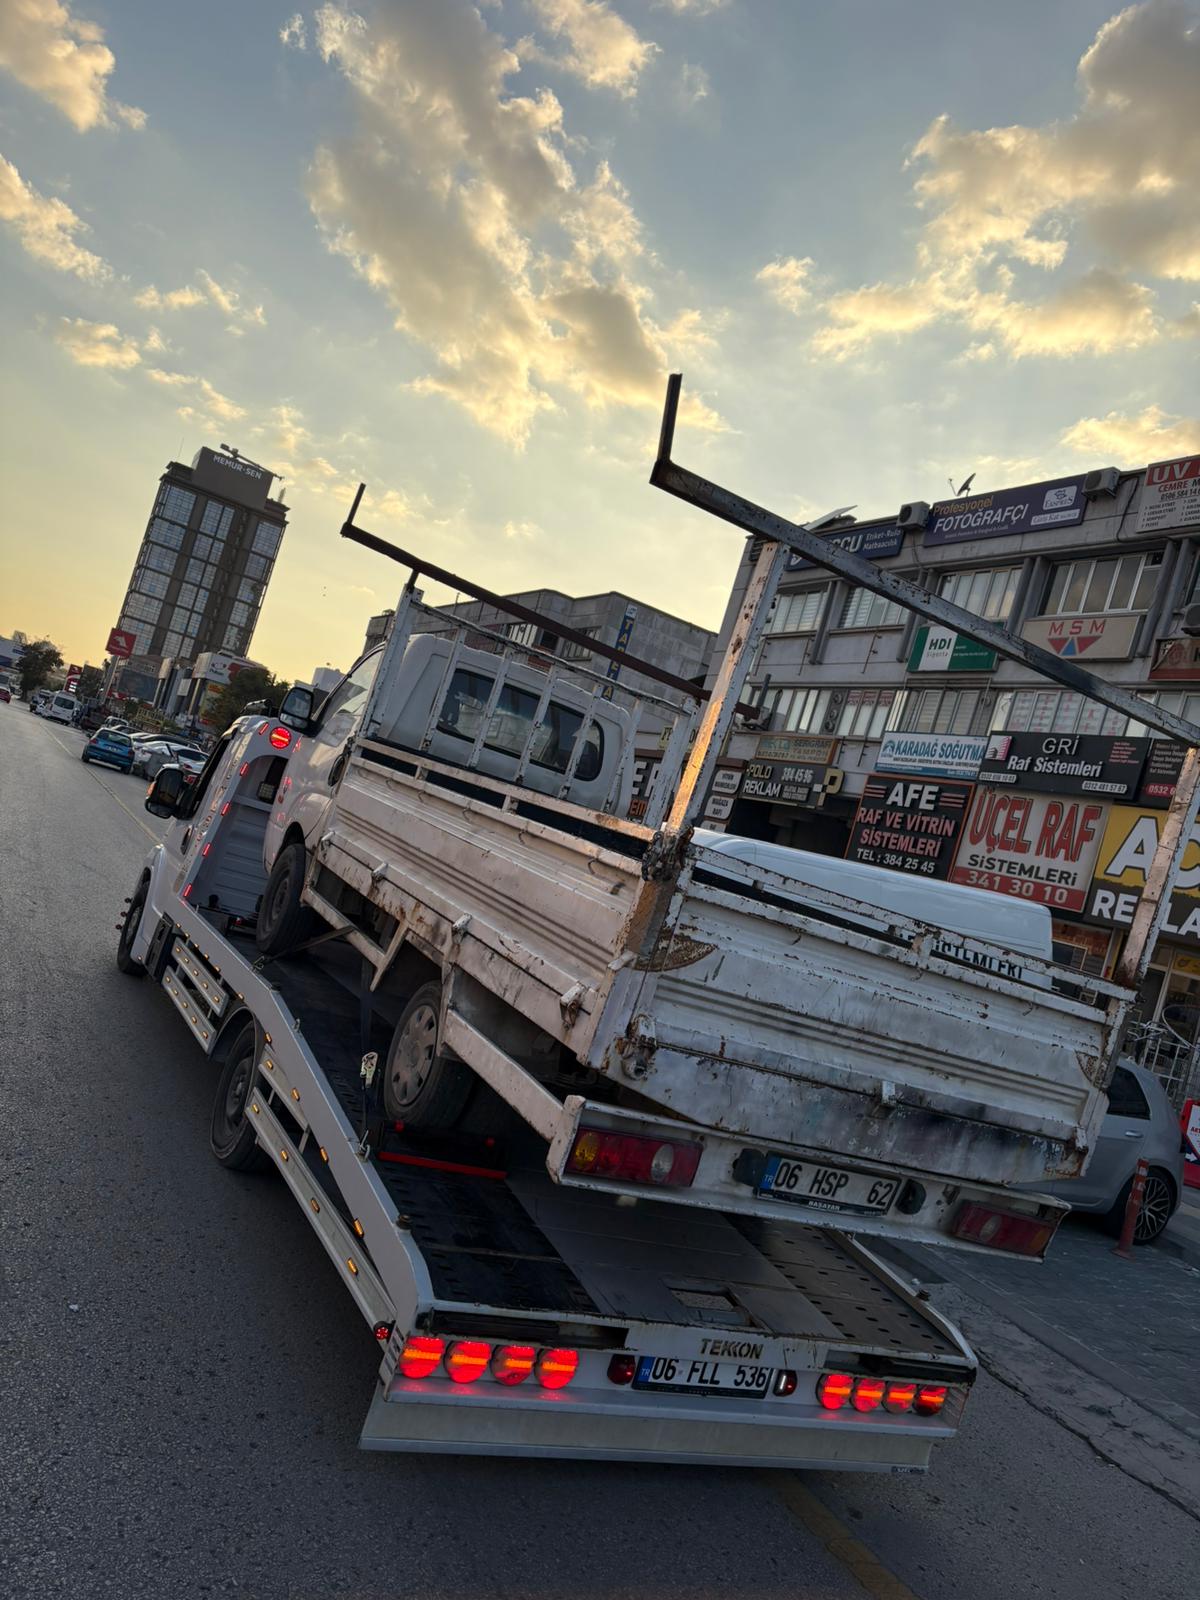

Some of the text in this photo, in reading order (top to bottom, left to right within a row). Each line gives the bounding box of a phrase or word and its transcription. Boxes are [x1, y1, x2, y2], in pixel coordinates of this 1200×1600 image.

[1158, 480, 1188, 493] CEMRE
[932, 495, 994, 517] Profesyonel
[933, 503, 1029, 533] FOTOĞRAFÇI
[929, 638, 952, 650] HDI
[894, 738, 985, 761] KARADAĞ SOĞUTMA
[747, 764, 773, 779] POLO
[1007, 755, 1103, 777] Raf Sistemleri
[742, 779, 781, 797] REKLAM
[886, 782, 939, 810] AFE
[857, 807, 956, 837] RAF VE VİTRİN
[969, 785, 1103, 863] ÜÇEL RAF
[860, 827, 943, 858] SİSTEMLERİ
[883, 853, 902, 867] 384
[904, 857, 918, 870] 25
[920, 862, 935, 873] 45
[966, 870, 1068, 903] 341 30 10
[764, 1161, 894, 1207] TR 06 HSP 62
[641, 1357, 769, 1388] TR 06 FLL 536
